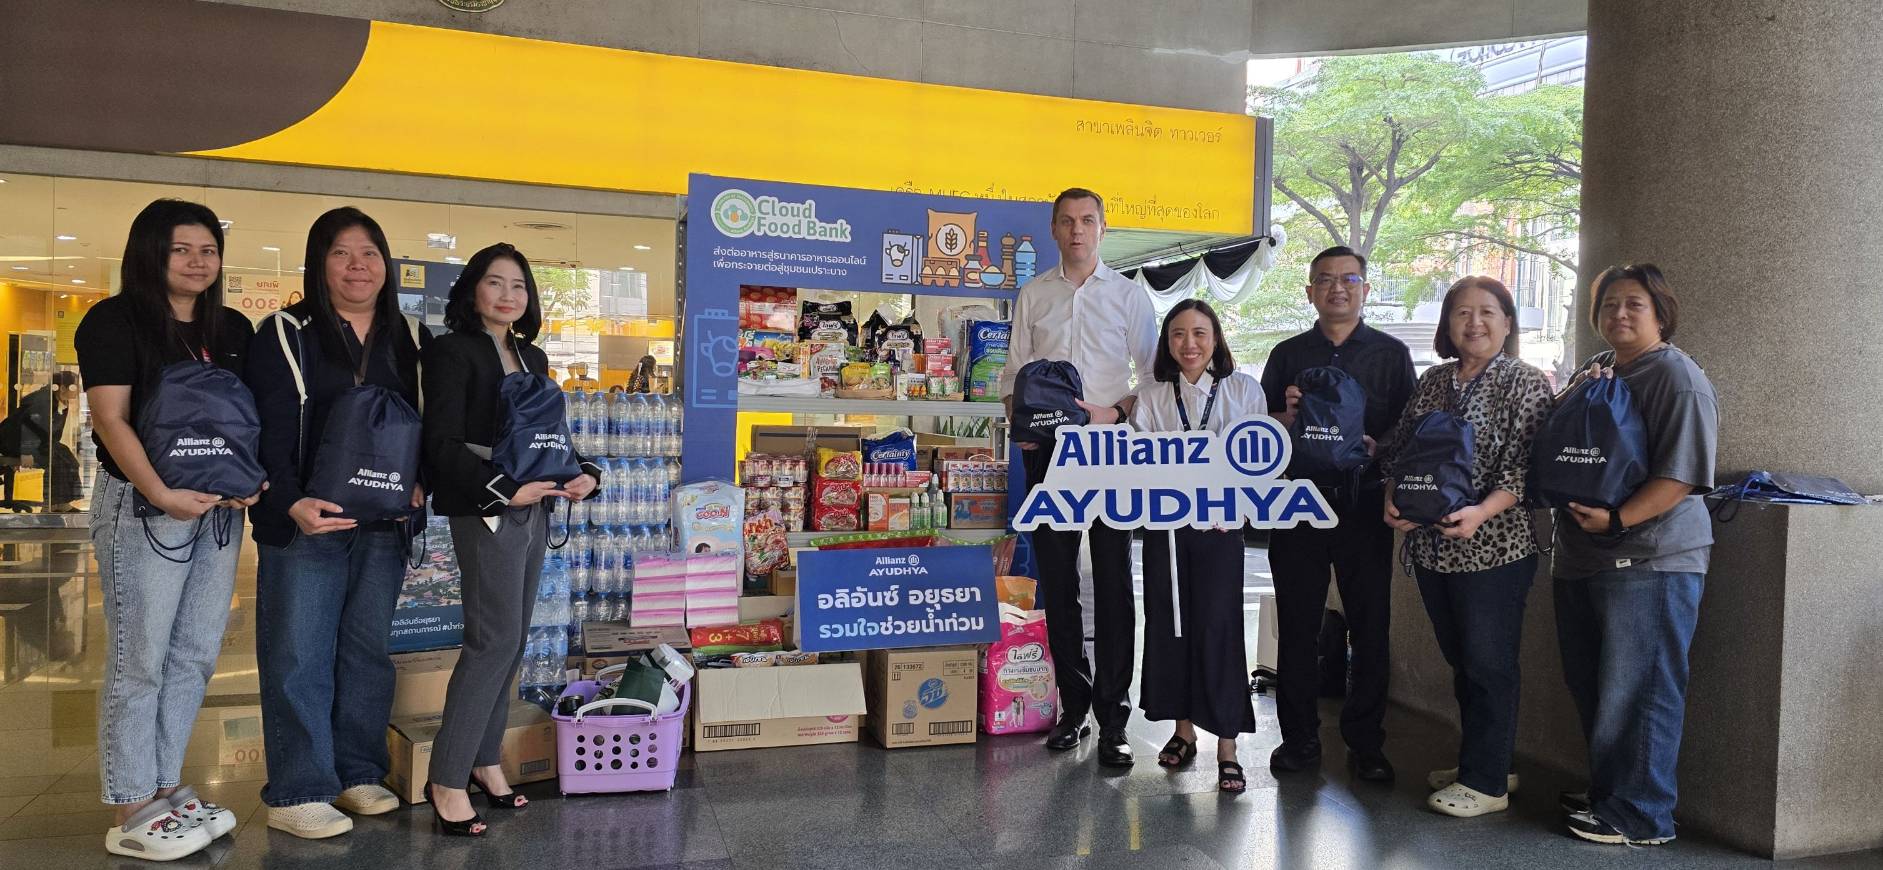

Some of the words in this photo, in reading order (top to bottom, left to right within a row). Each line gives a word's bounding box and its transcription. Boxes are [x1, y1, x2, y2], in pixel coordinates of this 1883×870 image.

[757, 198, 813, 219] Cloud
[756, 217, 802, 235] Food
[806, 220, 849, 239] Bank
[1029, 416, 1070, 428] AYUDHYA
[176, 438, 210, 447] Allianz
[534, 433, 560, 441] Allianz
[169, 447, 233, 458] AYUDHYA
[871, 449, 911, 460] Certainty
[1056, 430, 1210, 467] Allianz
[1555, 455, 1608, 464] AYUDHYA
[357, 468, 388, 480] Allianz
[347, 478, 404, 492] AYUDHYA
[1020, 486, 1331, 524] AYUDHYA
[875, 556, 906, 565] Allianz
[869, 566, 928, 577] AYUDHYA
[817, 584, 900, 609] อลิอันซ์
[908, 586, 982, 611] อยุธยา
[819, 608, 984, 639] รวมใจช่วยน้ำท่วม
